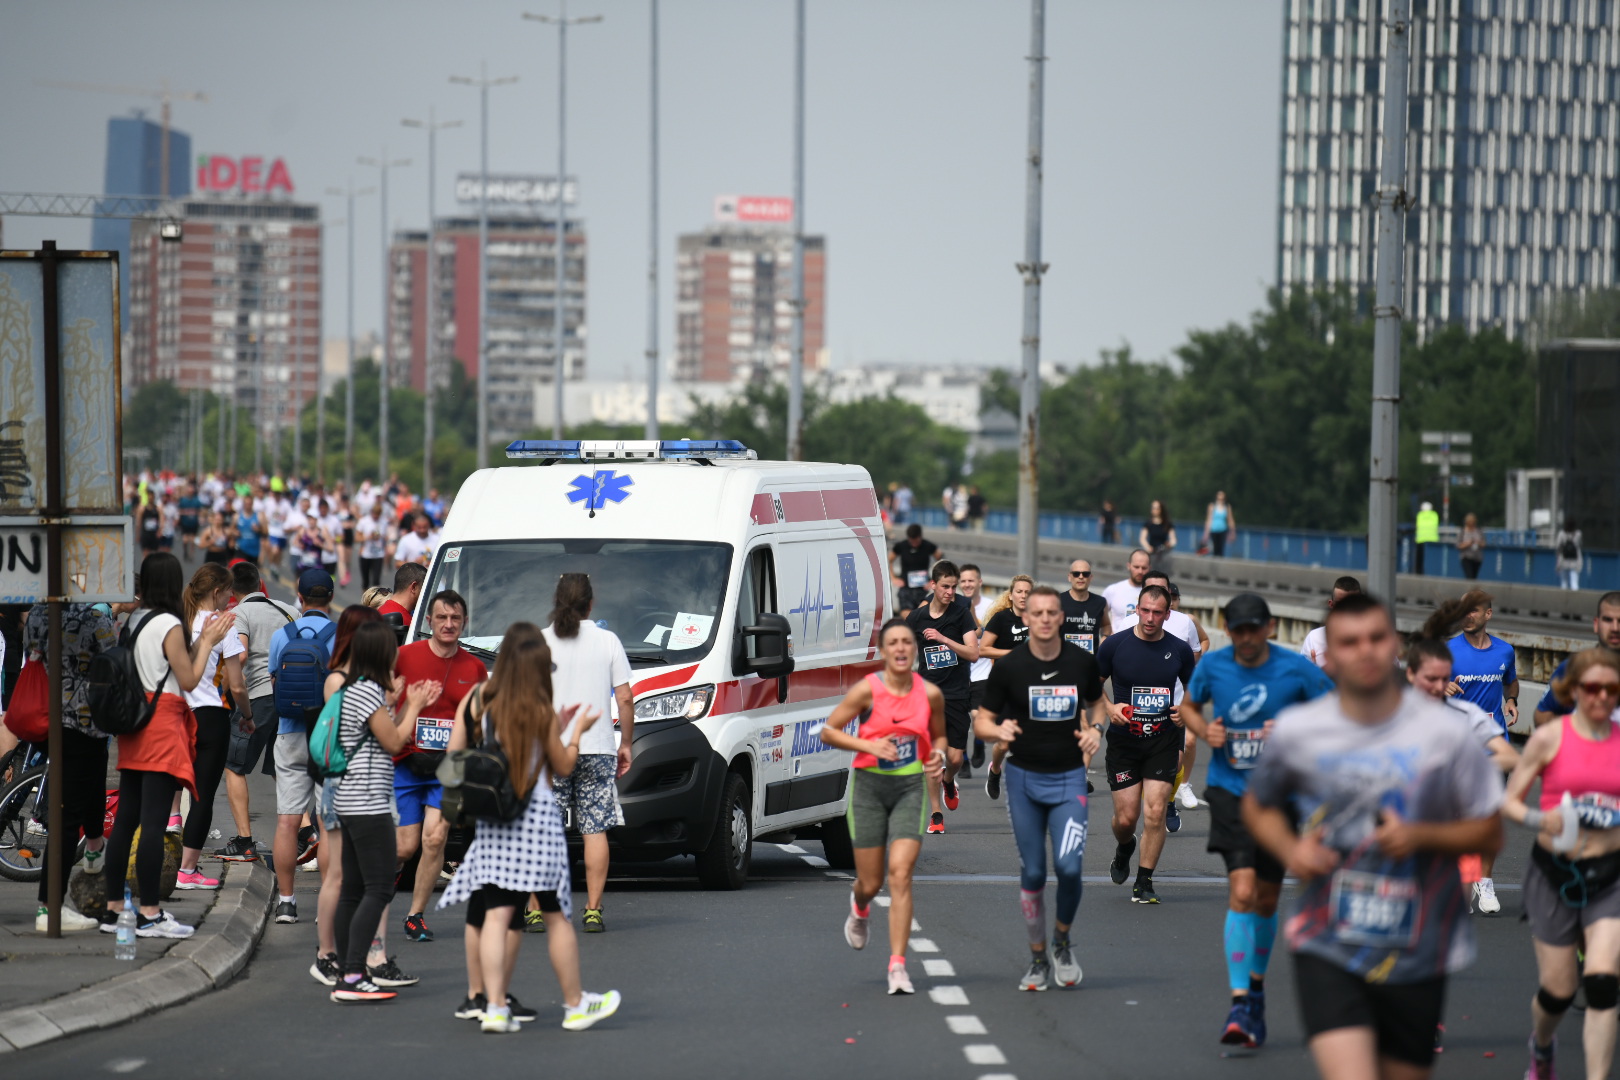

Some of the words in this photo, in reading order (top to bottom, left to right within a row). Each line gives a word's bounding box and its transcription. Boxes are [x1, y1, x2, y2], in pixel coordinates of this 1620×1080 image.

[930, 651, 951, 663] 5738
[1137, 695, 1165, 707] 4045
[421, 727, 450, 742] 3309
